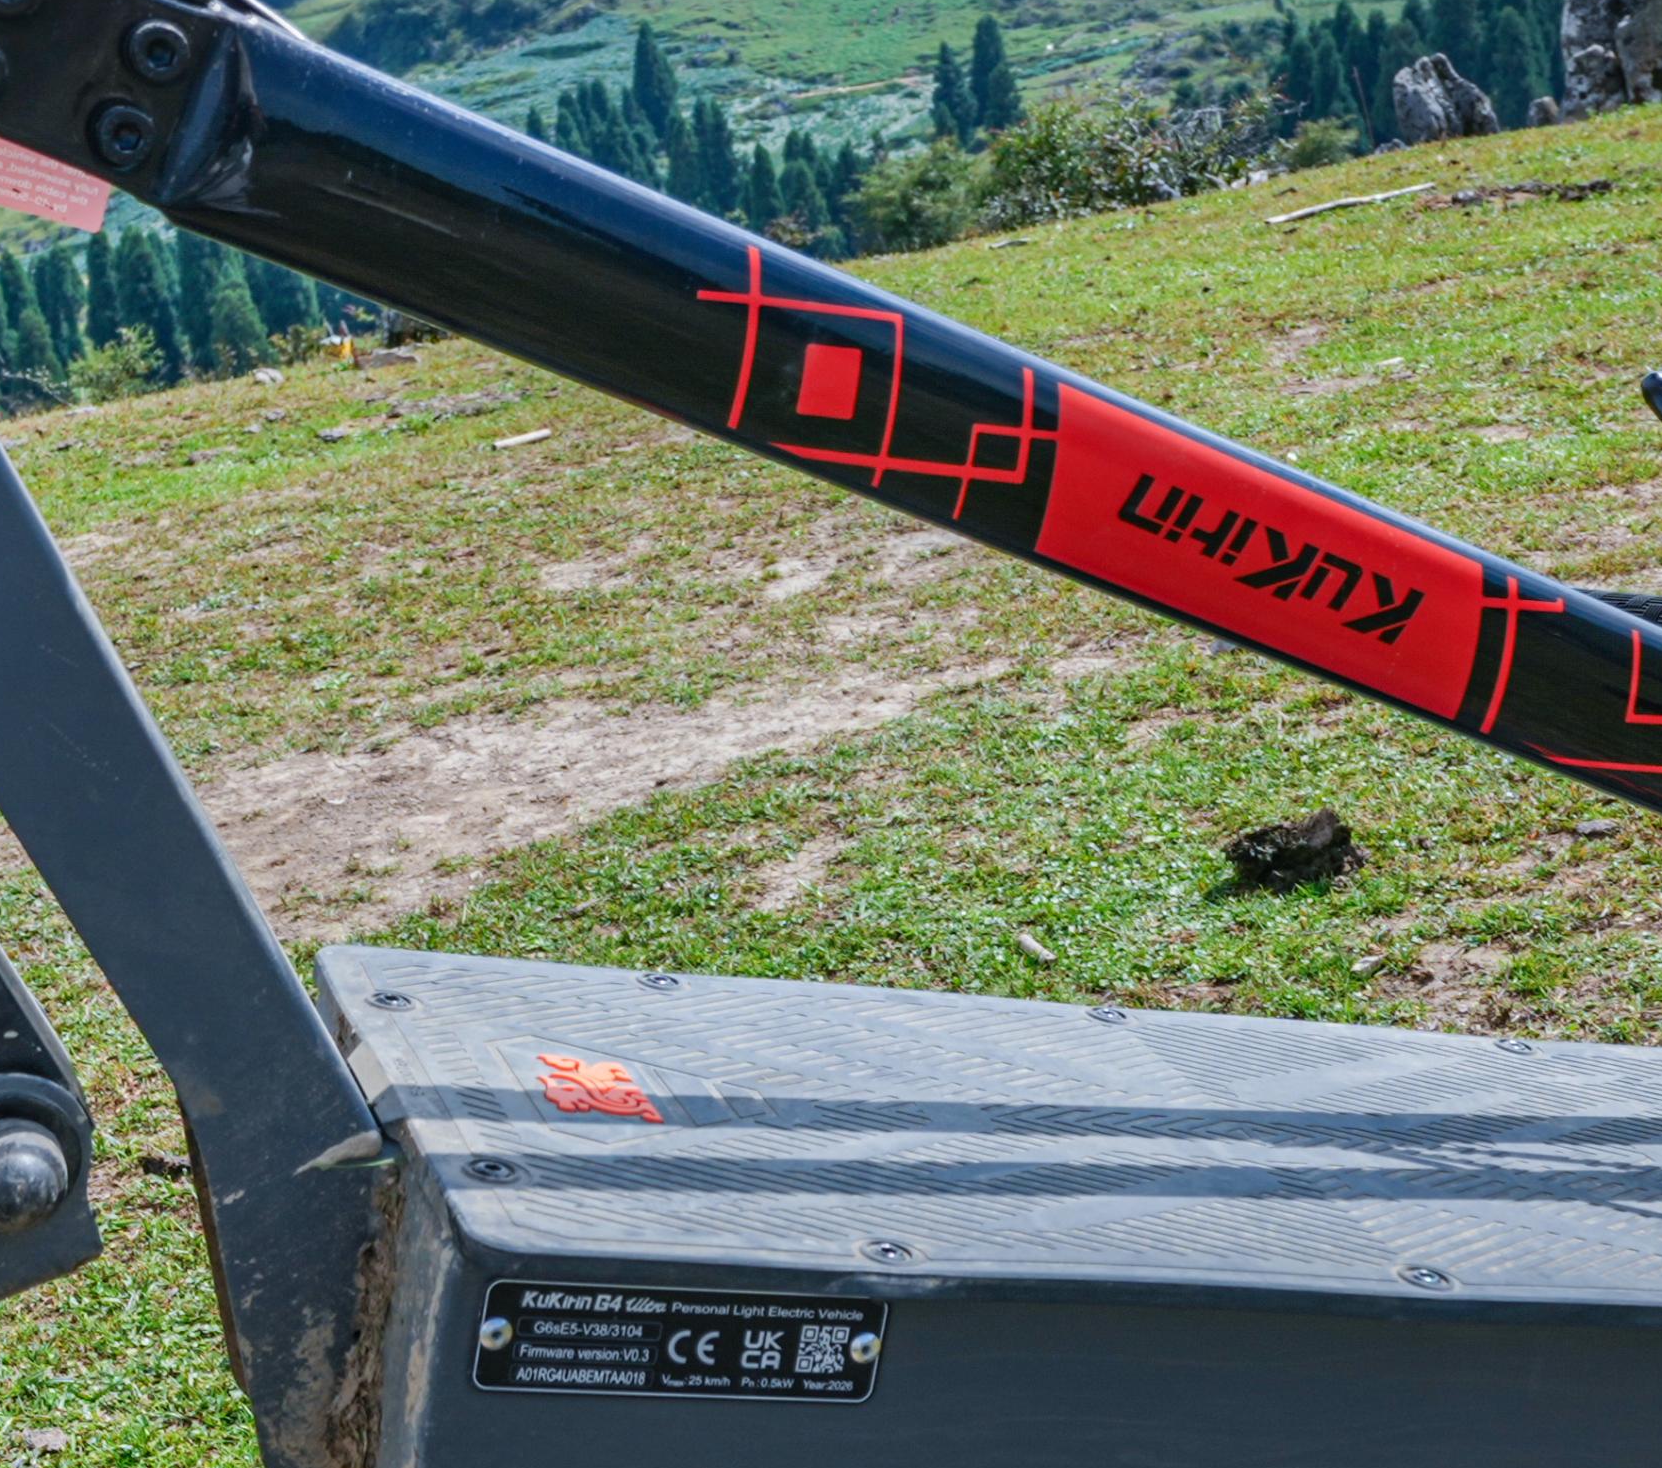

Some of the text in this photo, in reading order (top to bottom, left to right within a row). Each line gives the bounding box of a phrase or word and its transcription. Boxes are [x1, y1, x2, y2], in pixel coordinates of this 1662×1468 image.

[594, 1294, 623, 1313] G4
[625, 1297, 667, 1314] Ultra
[671, 1302, 730, 1317] Personal
[734, 1304, 765, 1320] Light
[769, 1306, 814, 1320] Electric
[818, 1309, 864, 1322] Vehicle
[667, 1330, 720, 1365] CE
[744, 1330, 784, 1351] UK
[519, 1344, 575, 1360] Firmware
[741, 1350, 781, 1370] CA
